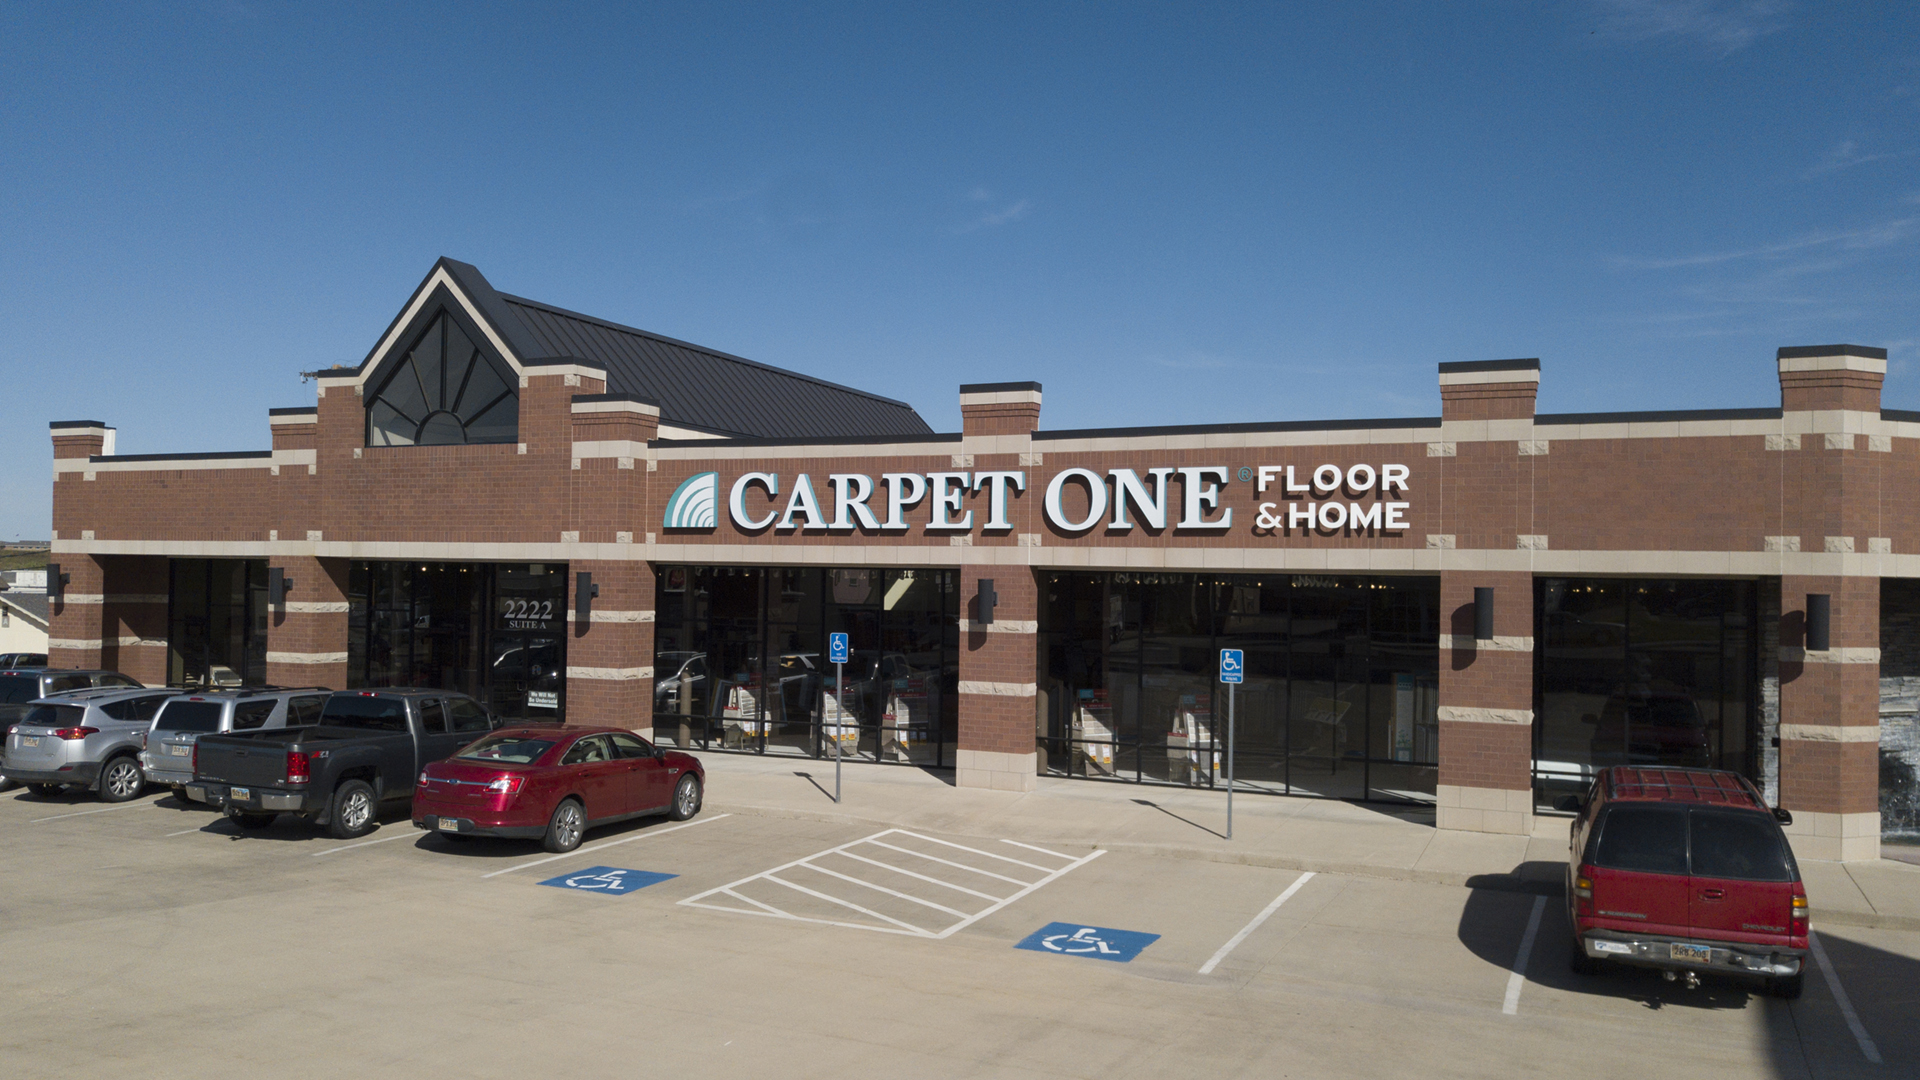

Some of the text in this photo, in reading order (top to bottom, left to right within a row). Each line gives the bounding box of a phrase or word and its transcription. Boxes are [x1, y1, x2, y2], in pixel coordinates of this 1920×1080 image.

[1257, 463, 1410, 492] FLOOR
[729, 471, 1026, 530] CARPET
[1045, 466, 1233, 531] ONE
[504, 600, 553, 620] 2222
[509, 620, 547, 629] SUITE A
